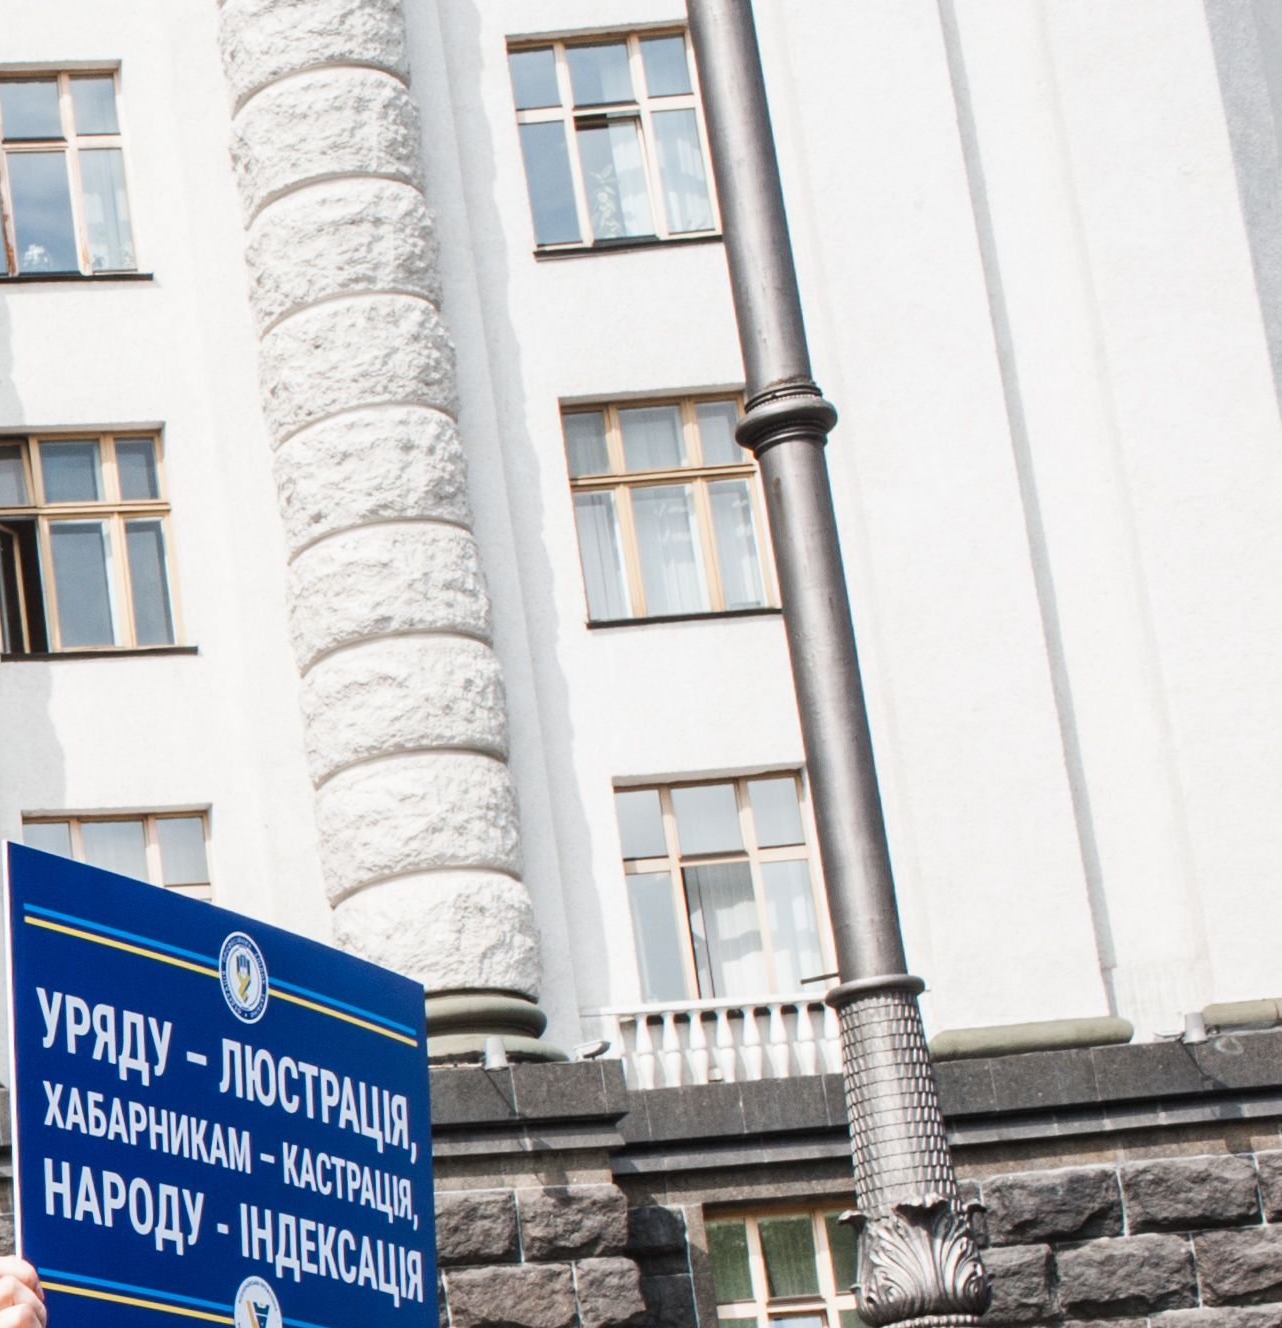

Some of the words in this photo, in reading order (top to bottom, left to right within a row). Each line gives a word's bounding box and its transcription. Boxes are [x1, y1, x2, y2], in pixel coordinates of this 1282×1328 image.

[36, 987, 173, 1087] УРЯДУ
[219, 1038, 417, 1164] ЛЮСТРАЦІЯ,
[42, 1080, 252, 1174] ХАБАРНИКАМ
[282, 1142, 419, 1231] КАСТРАЦІЯ,
[44, 1157, 205, 1256] НАРОДУ
[240, 1203, 424, 1308] ІНДЕКСАЦІЯ
